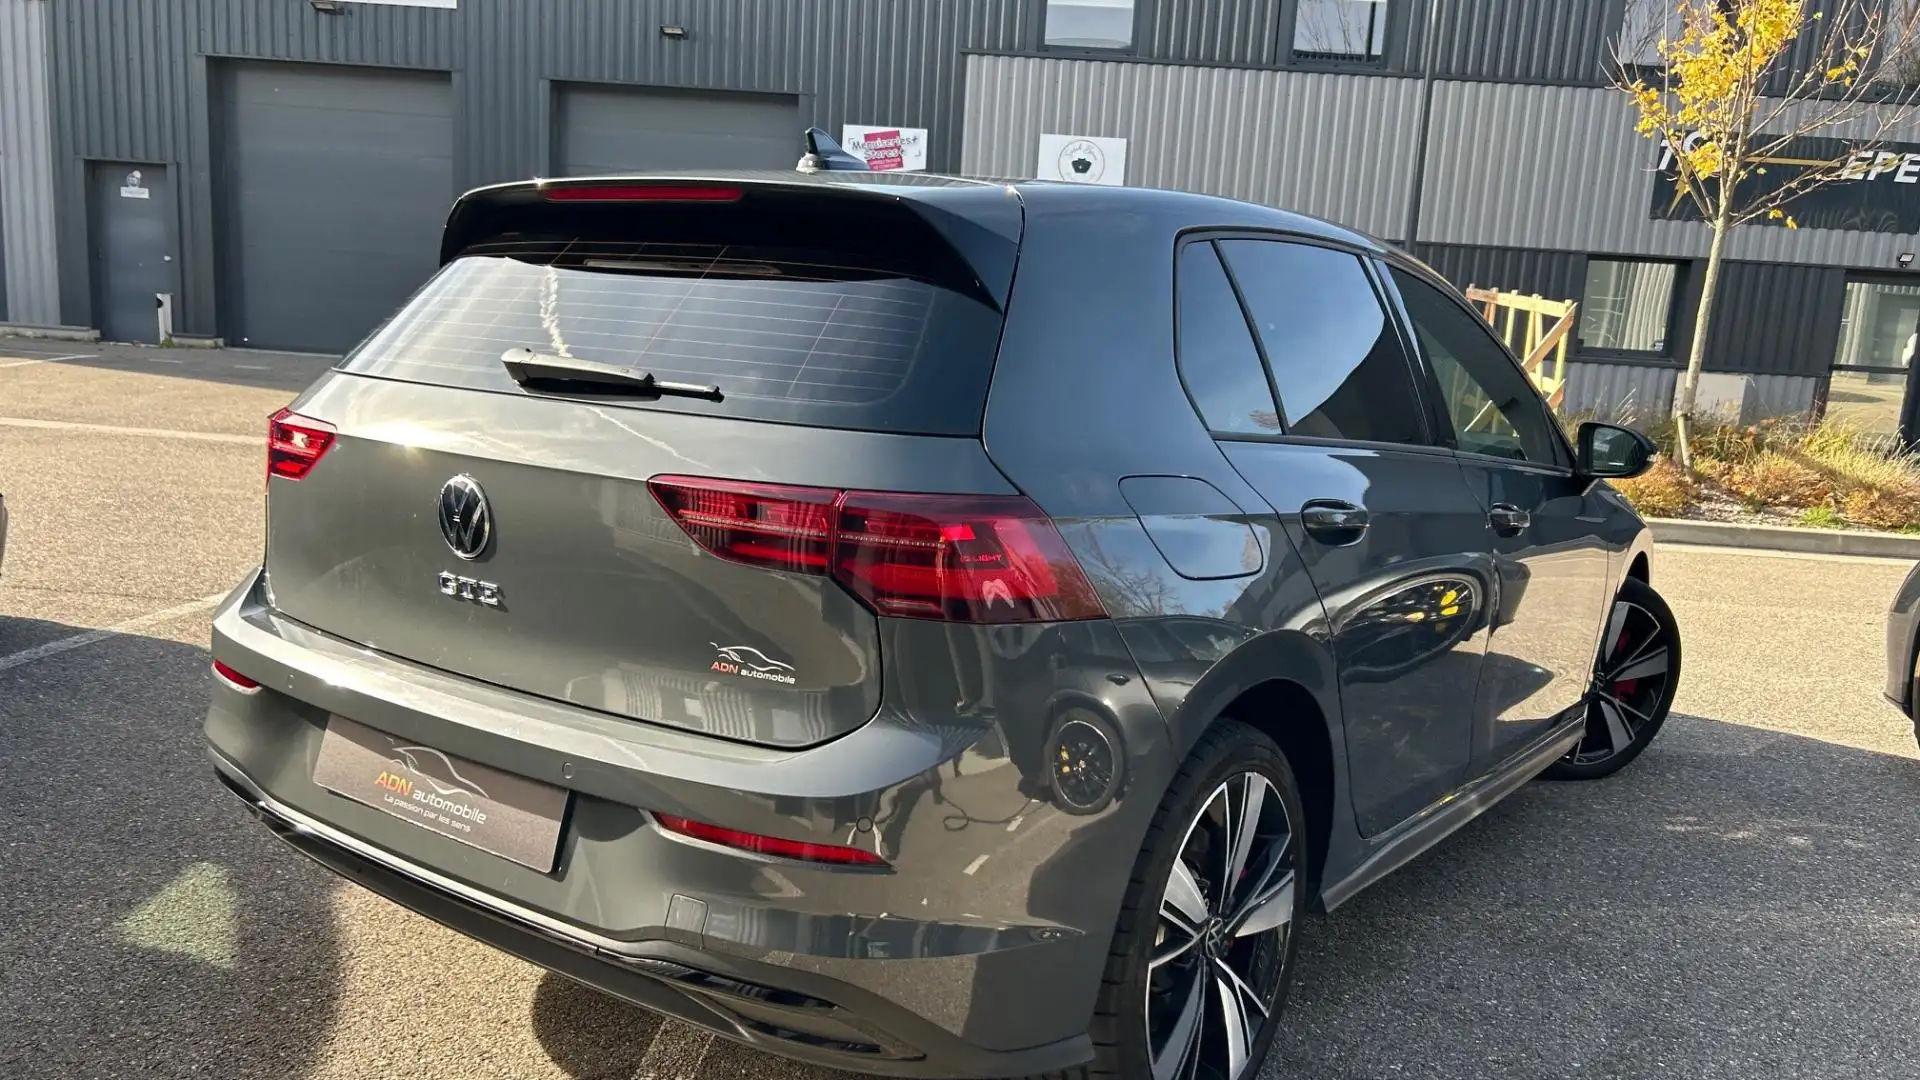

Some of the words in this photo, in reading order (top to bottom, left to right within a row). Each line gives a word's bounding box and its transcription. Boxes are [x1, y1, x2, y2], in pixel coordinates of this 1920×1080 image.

[439, 570, 499, 605] GTE
[711, 661, 738, 675] ADN
[740, 669, 796, 685] automobile
[375, 771, 413, 796] ADN
[413, 789, 487, 824] automobile
[384, 793, 393, 803] La
[394, 798, 424, 814] passion
[423, 808, 438, 821] par
[439, 814, 450, 825] les
[451, 820, 471, 832] sens
